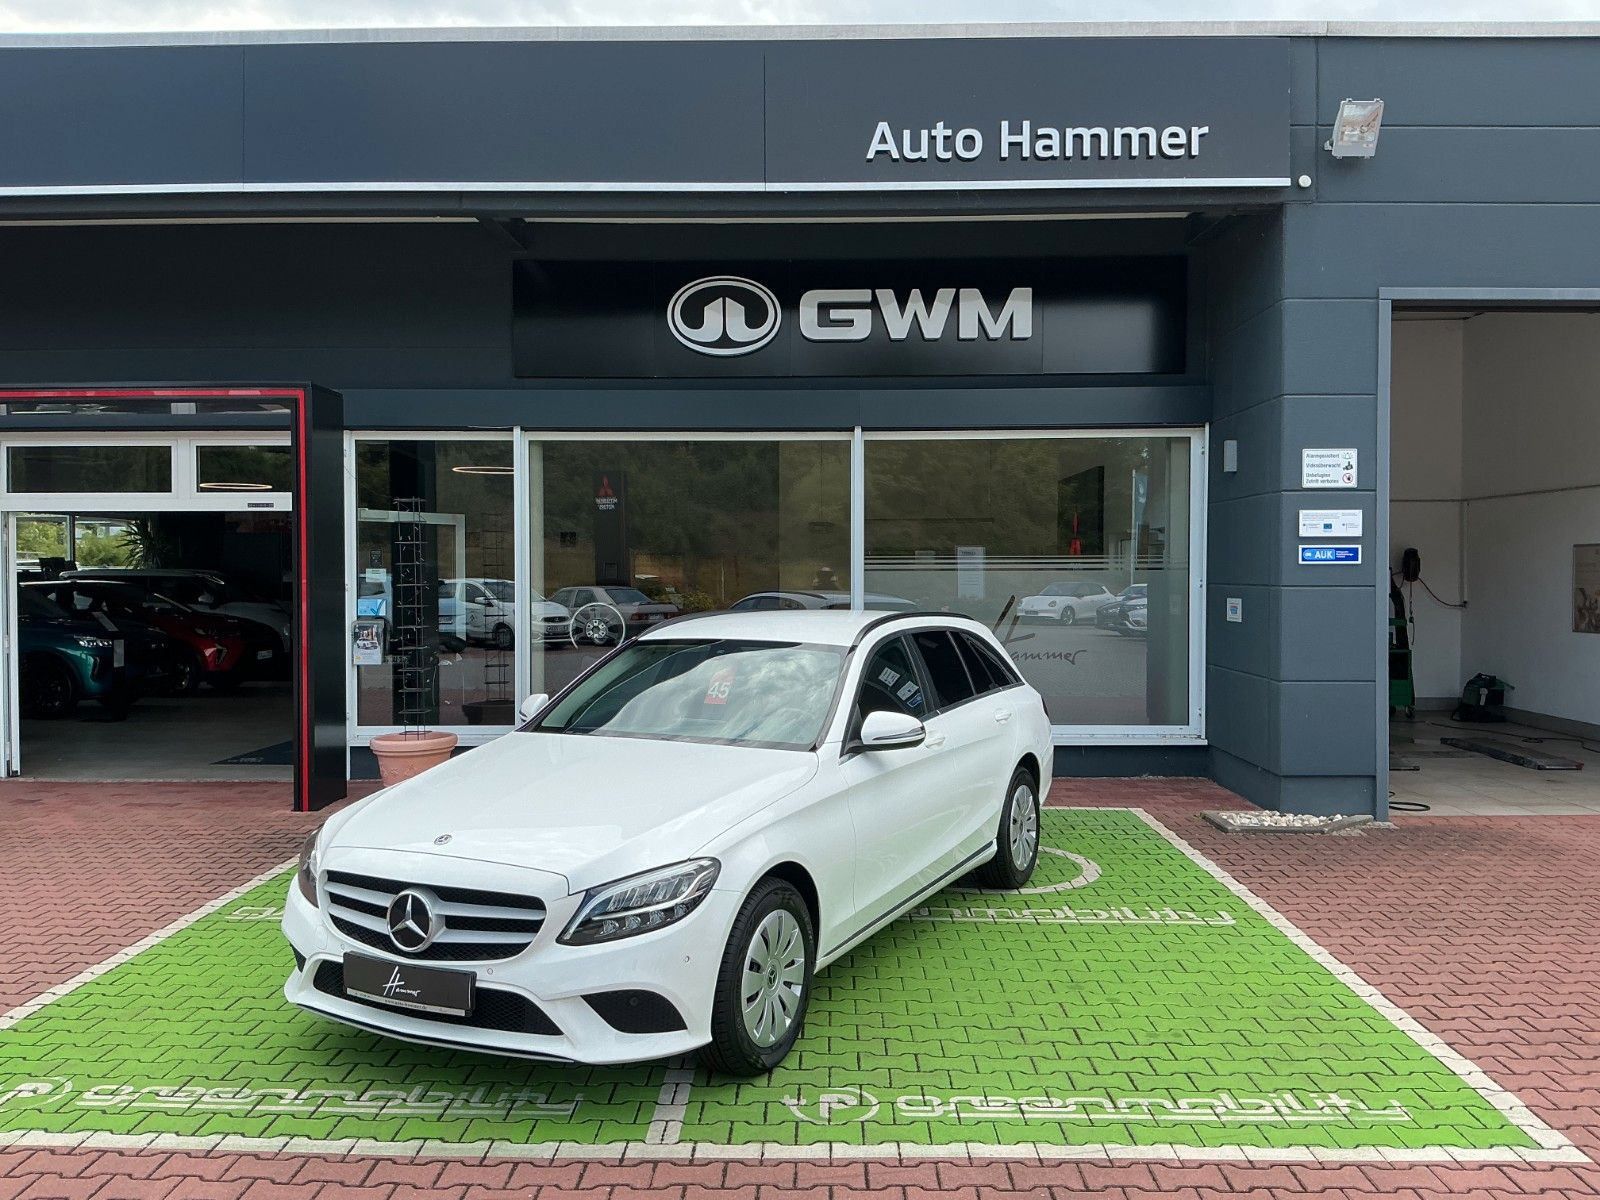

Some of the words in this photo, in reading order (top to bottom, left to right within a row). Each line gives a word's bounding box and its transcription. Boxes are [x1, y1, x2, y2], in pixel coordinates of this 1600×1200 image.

[865, 121, 984, 161] Auto
[1001, 119, 1209, 159] Hammer
[799, 287, 1033, 341] GWM
[76, 1085, 584, 1116] greenmobility
[897, 1092, 1410, 1121] greenmobility
